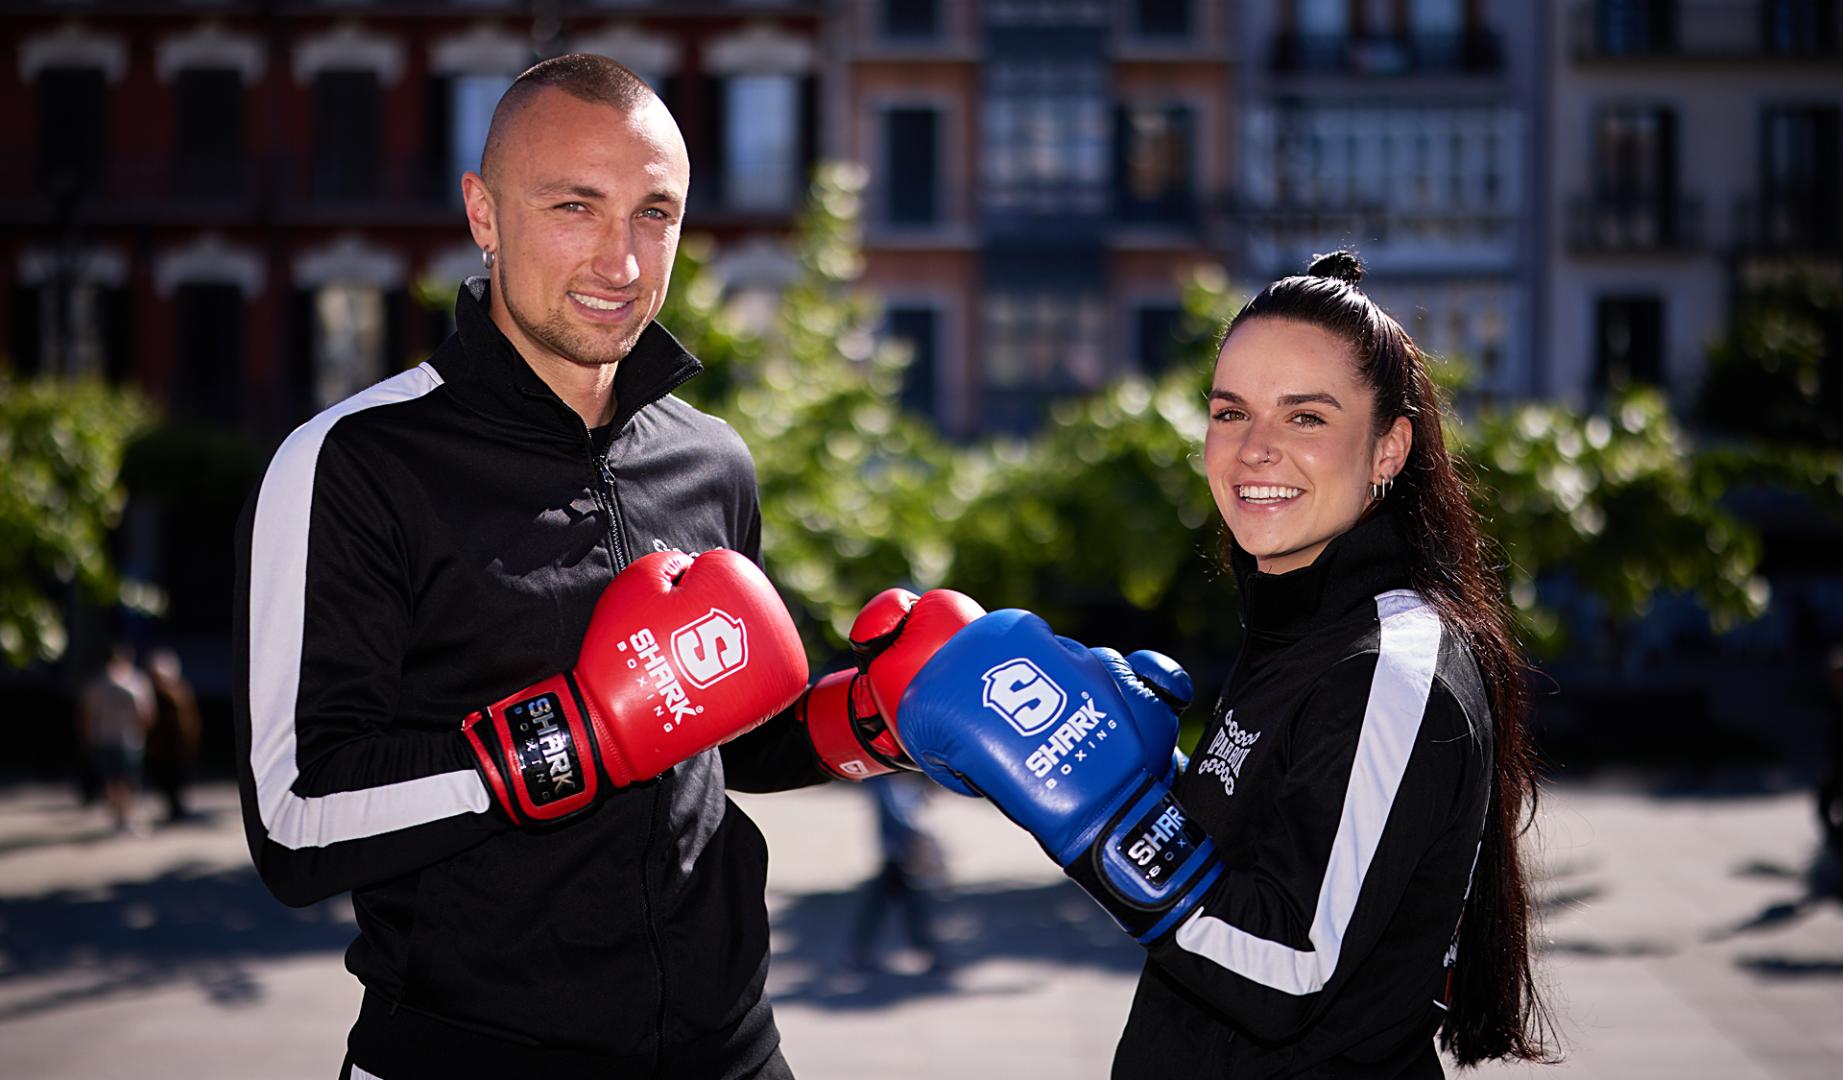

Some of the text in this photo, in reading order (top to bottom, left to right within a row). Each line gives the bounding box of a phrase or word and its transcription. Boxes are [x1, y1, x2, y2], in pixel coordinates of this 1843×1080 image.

[616, 641, 674, 733] BOXING
[528, 697, 576, 793] SHARK
[1045, 719, 1117, 790] BOXING
[1128, 805, 1187, 866] SHAR
[1148, 838, 1187, 877] BOX
